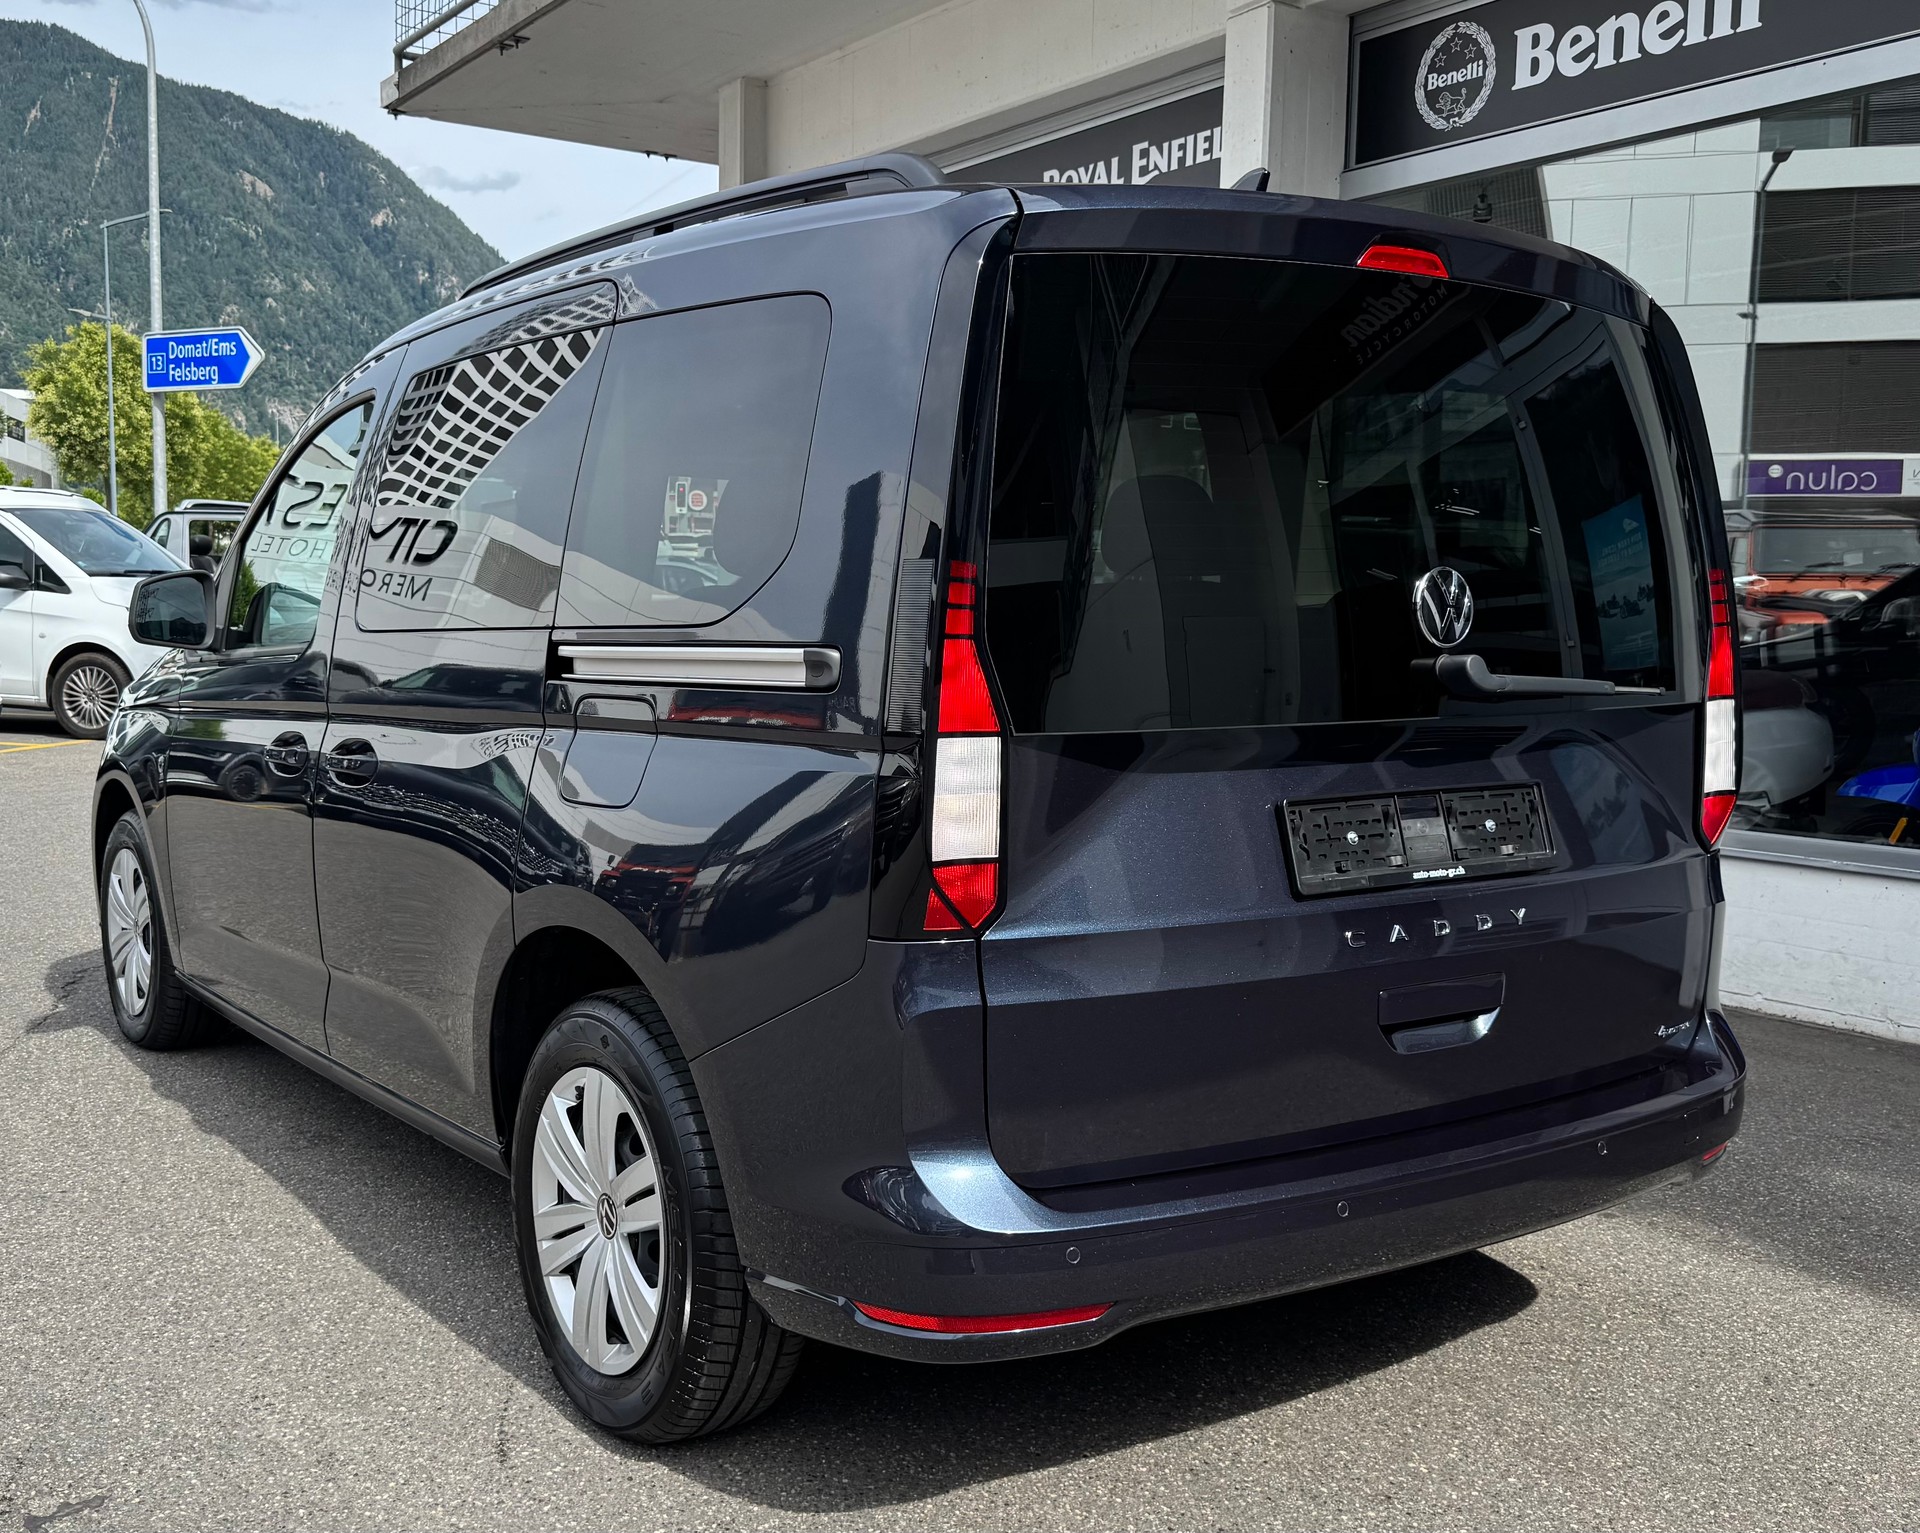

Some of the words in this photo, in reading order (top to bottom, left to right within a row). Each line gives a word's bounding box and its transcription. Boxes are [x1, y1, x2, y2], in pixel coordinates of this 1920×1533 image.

[1427, 60, 1484, 91] Benelli
[168, 338, 237, 360] Domat/Ems
[151, 356, 163, 371] 13
[168, 361, 219, 385] Felsberg
[1344, 907, 1526, 948] CADDY
